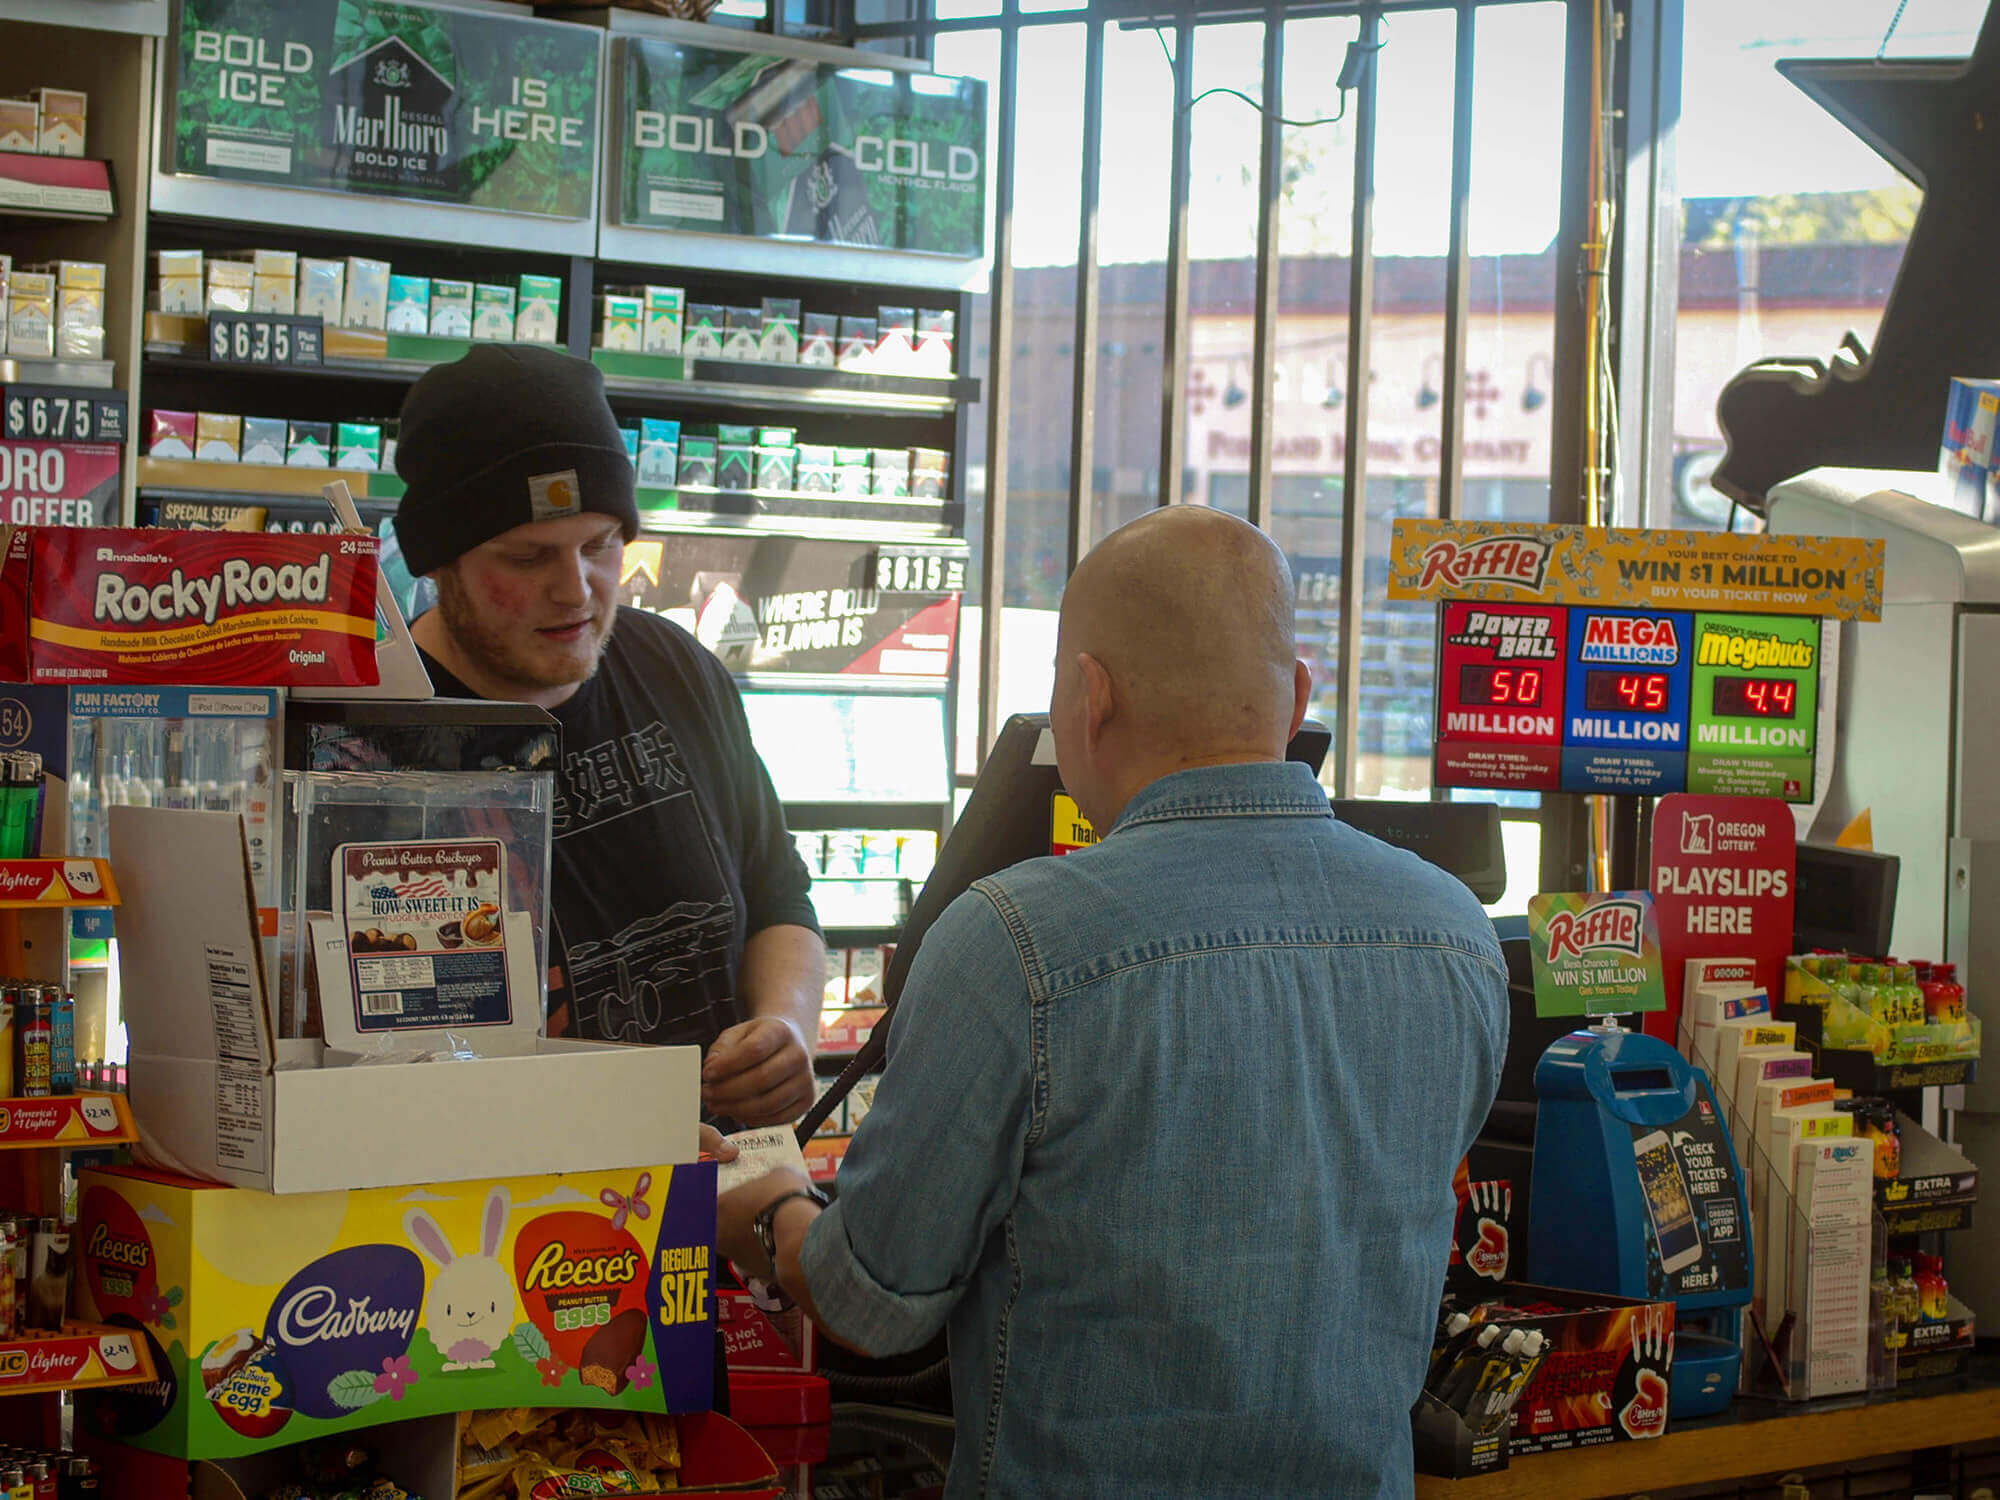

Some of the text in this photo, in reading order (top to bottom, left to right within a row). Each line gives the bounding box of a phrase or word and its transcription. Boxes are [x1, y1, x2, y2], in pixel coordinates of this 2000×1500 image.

[194, 30, 313, 74] BOLD
[218, 69, 285, 107] ICE
[512, 77, 548, 108] IS
[332, 95, 449, 157] Marlboro
[472, 106, 583, 147] HERE
[635, 109, 768, 160] BOLD
[354, 151, 428, 171] BOLD ICE
[854, 135, 979, 181] COLD
[102, 406, 119, 418] Tax
[11, 496, 93, 527] OFFER
[165, 503, 209, 522] SPECIAL
[340, 540, 357, 554] 24
[1667, 549, 1798, 564] YOUR BEST CHANCE TO
[1419, 541, 1541, 588] Raffle
[1617, 559, 1846, 590] WIN $1 MILLION
[95, 554, 330, 624] Rocky Road
[1651, 586, 1808, 604] BUY YOUR TICKET NOW
[100, 613, 320, 649] Handmade Milk Chocolate Coated Marshmallow with Cashews
[842, 617, 864, 647] IS
[1467, 612, 1551, 637] POWER
[1586, 616, 1676, 646] MEGA
[1494, 633, 1559, 660] BALL
[1582, 643, 1677, 664] MILLIONS
[1698, 631, 1814, 669] megabucks
[289, 649, 326, 667] Original
[1491, 671, 1540, 702] 50
[1617, 677, 1665, 707] 45
[75, 693, 160, 707] FUN FACTORY
[111, 707, 146, 715] NOVELTY
[1447, 713, 1555, 735] MILLION
[1571, 718, 1681, 743] MILLION
[1697, 724, 1807, 748] MILLION
[1447, 760, 1497, 771] Wednesday
[1509, 763, 1549, 774] Saturday
[1468, 752, 1529, 763] DRAW TIMES:
[1593, 757, 1655, 768] DRAW TIMES:
[1712, 758, 1774, 769] DRAW TIMES:
[1508, 772, 1527, 780] PST
[1585, 765, 1625, 777] Tuesday
[1633, 768, 1662, 778] Friday
[1633, 777, 1652, 785] PST
[1736, 768, 1787, 779] Wednesday
[1727, 777, 1767, 788] Saturday
[1071, 823, 1097, 845] Than
[1717, 822, 1765, 837] OREGON
[1717, 840, 1756, 852] LOTTERY
[363, 850, 483, 867] Peanut Butter Buckeyes
[1656, 866, 1788, 897] PLAYSLIPS
[372, 895, 481, 916] HOW SWEET IT IS
[385, 914, 414, 923] FUDGE
[422, 913, 452, 922] CANDY
[1687, 905, 1753, 935] HERE
[1547, 905, 1635, 962] Raffle
[1582, 958, 1609, 969] Chance
[1552, 970, 1579, 987] WIN
[1597, 967, 1647, 985] MILLION
[1578, 985, 1594, 996] Get
[1595, 985, 1615, 996] Yours
[13, 1107, 58, 1121] America's
[25, 1117, 58, 1132] Lighter
[1683, 1142, 1716, 1156] CHECK
[1686, 1156, 1714, 1168] YOUR
[1688, 1167, 1728, 1181] TICKETS
[1690, 1183, 1720, 1195] HERE!
[1913, 1177, 1951, 1192] EXTRA
[1708, 1210, 1734, 1218] OREGON
[1713, 1226, 1734, 1238] APP
[87, 1223, 150, 1267] Reese's
[524, 1241, 640, 1291] Reese's
[660, 1245, 709, 1272] REGULAR
[1682, 1275, 1709, 1288] HERE
[558, 1294, 608, 1307] PEANUT BUTTER
[660, 1271, 709, 1326] SIZE
[277, 1286, 416, 1347] Cadbury
[1913, 1325, 1951, 1340] EXTRA
[739, 1339, 764, 1352] Late
[31, 1348, 78, 1374] Lighter
[227, 1394, 262, 1413] egg
